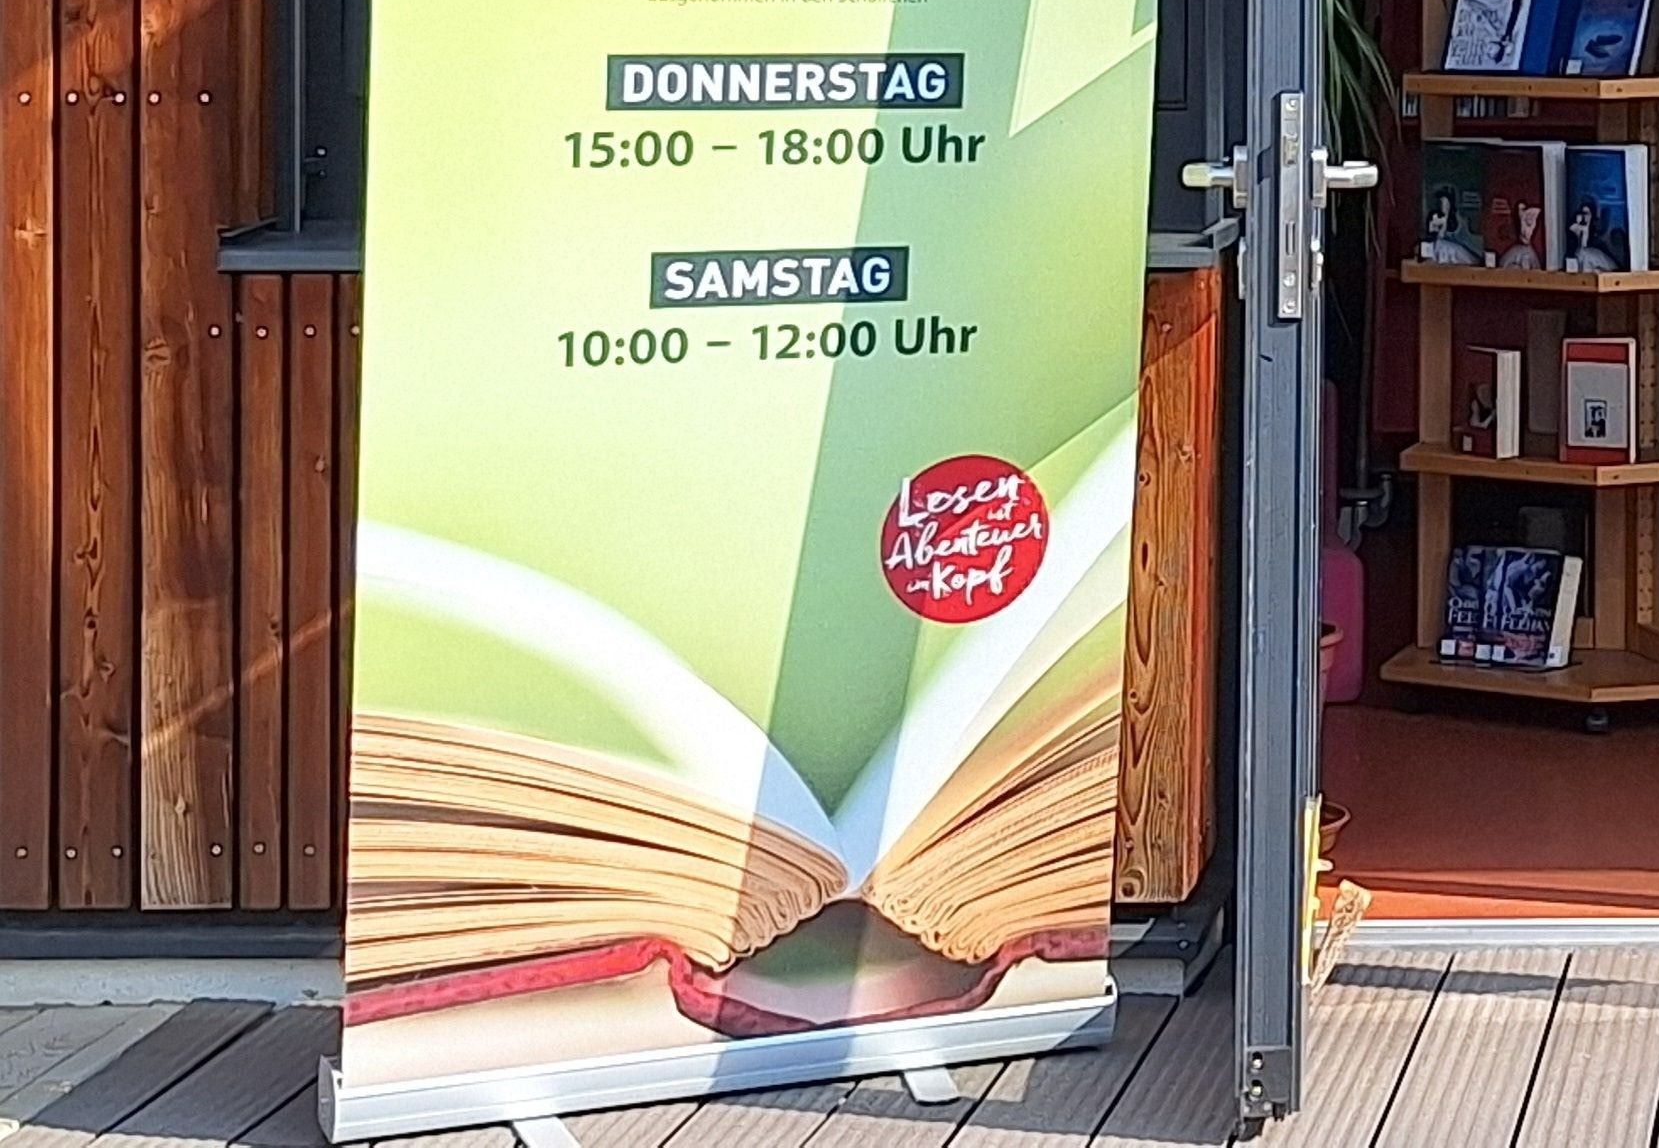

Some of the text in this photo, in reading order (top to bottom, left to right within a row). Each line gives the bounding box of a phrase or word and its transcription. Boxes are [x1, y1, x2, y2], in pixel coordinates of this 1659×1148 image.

[623, 63, 945, 102] DONNERSTAG
[565, 131, 693, 168] 15:00
[759, 128, 884, 165] 18:00
[902, 124, 985, 163] Uhr
[664, 257, 892, 299] SAMSTAG
[558, 328, 688, 367] 10:00
[753, 321, 876, 360] 12:00
[895, 316, 977, 355] Uhr
[899, 475, 1025, 527] Lesen
[987, 501, 1018, 521] ist
[885, 514, 1042, 570] Abenteuer
[931, 545, 1014, 605] Kopf
